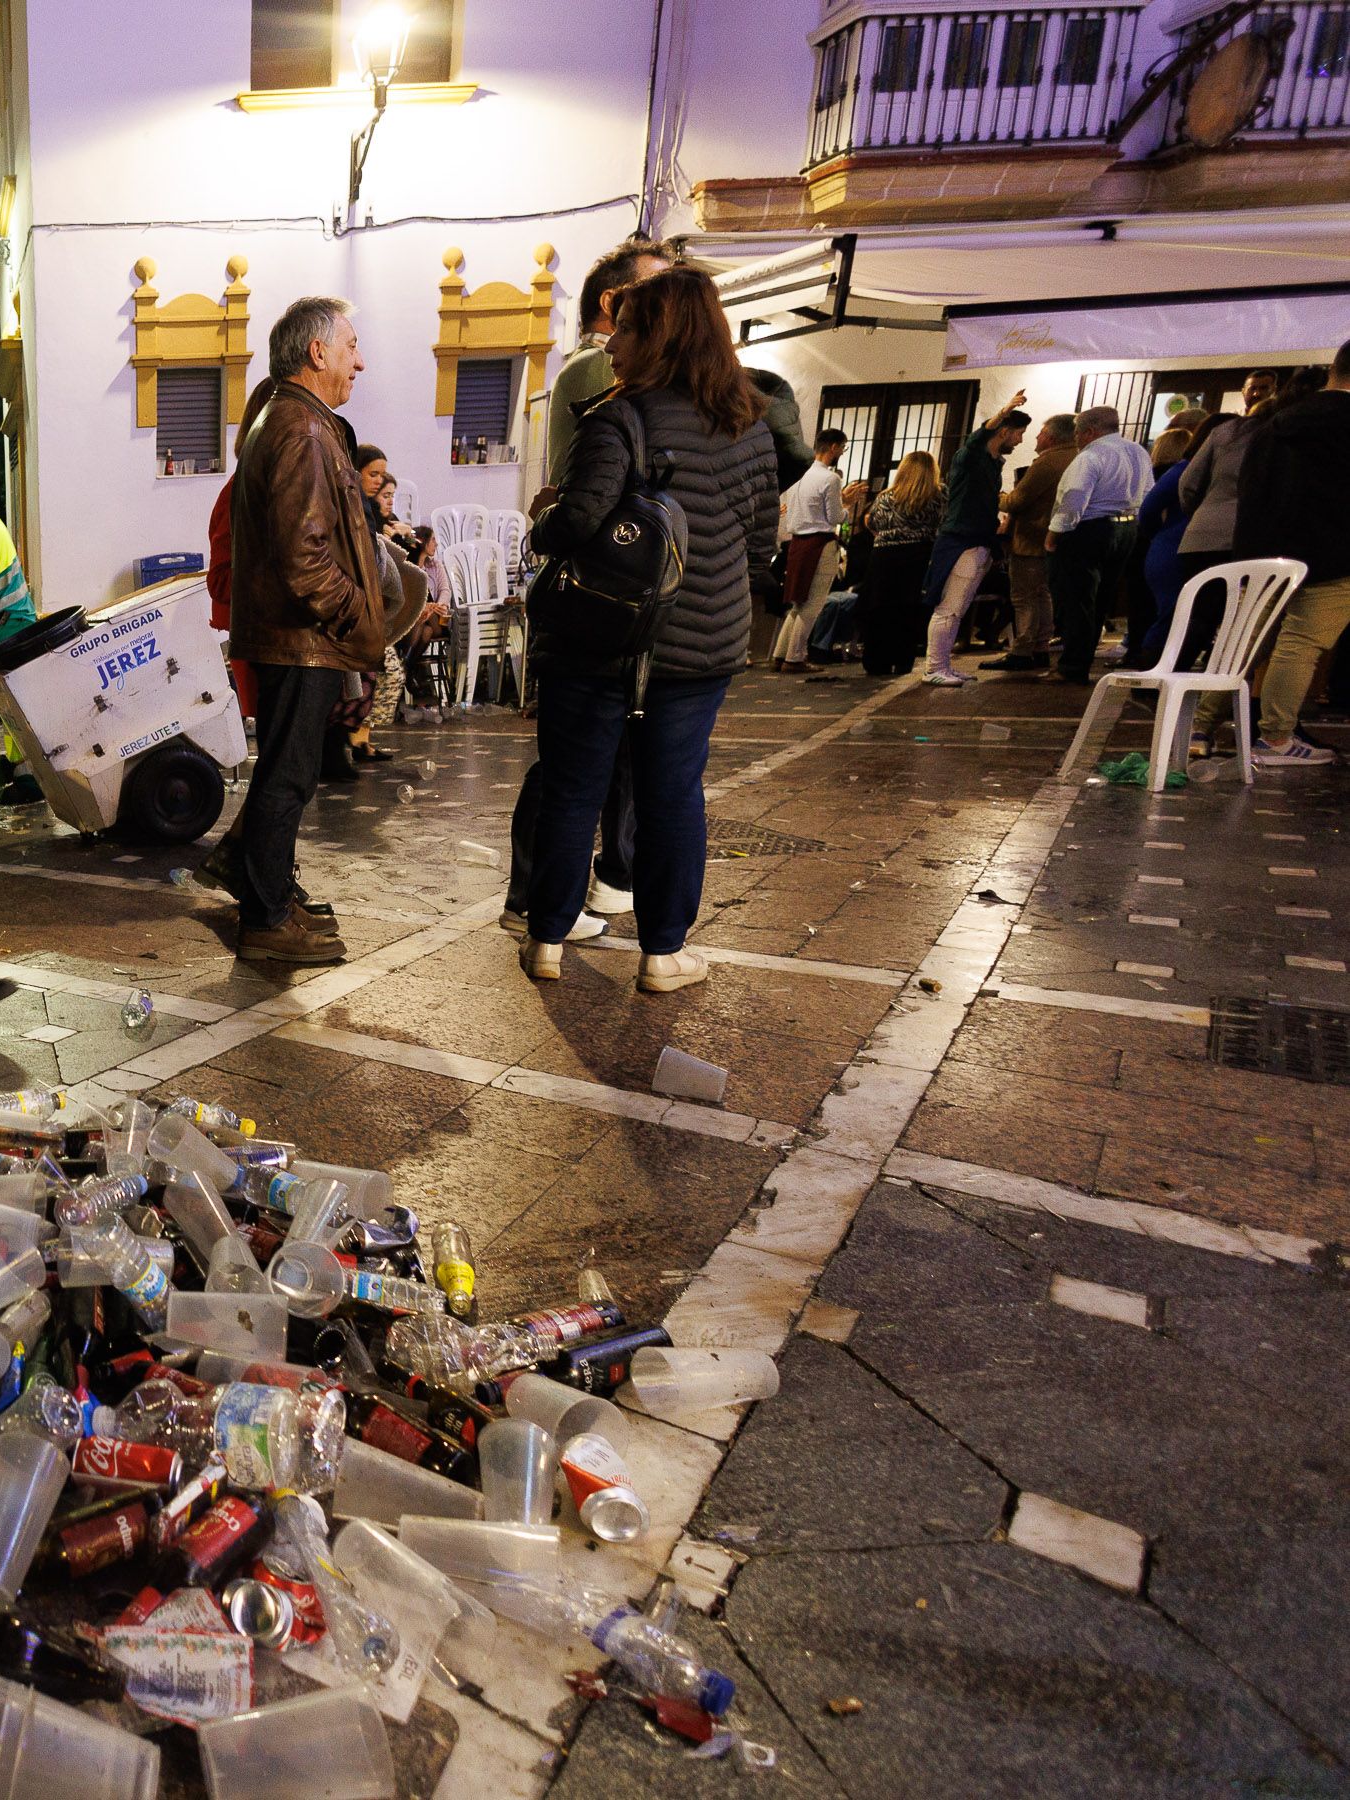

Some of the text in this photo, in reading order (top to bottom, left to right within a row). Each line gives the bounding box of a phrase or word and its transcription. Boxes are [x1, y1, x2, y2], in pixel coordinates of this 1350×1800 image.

[70, 609, 163, 658] GRUPO BRIGADA
[129, 631, 154, 647] mejorar
[97, 638, 162, 690] JEREZ
[120, 725, 172, 758] JEREZ UTE
